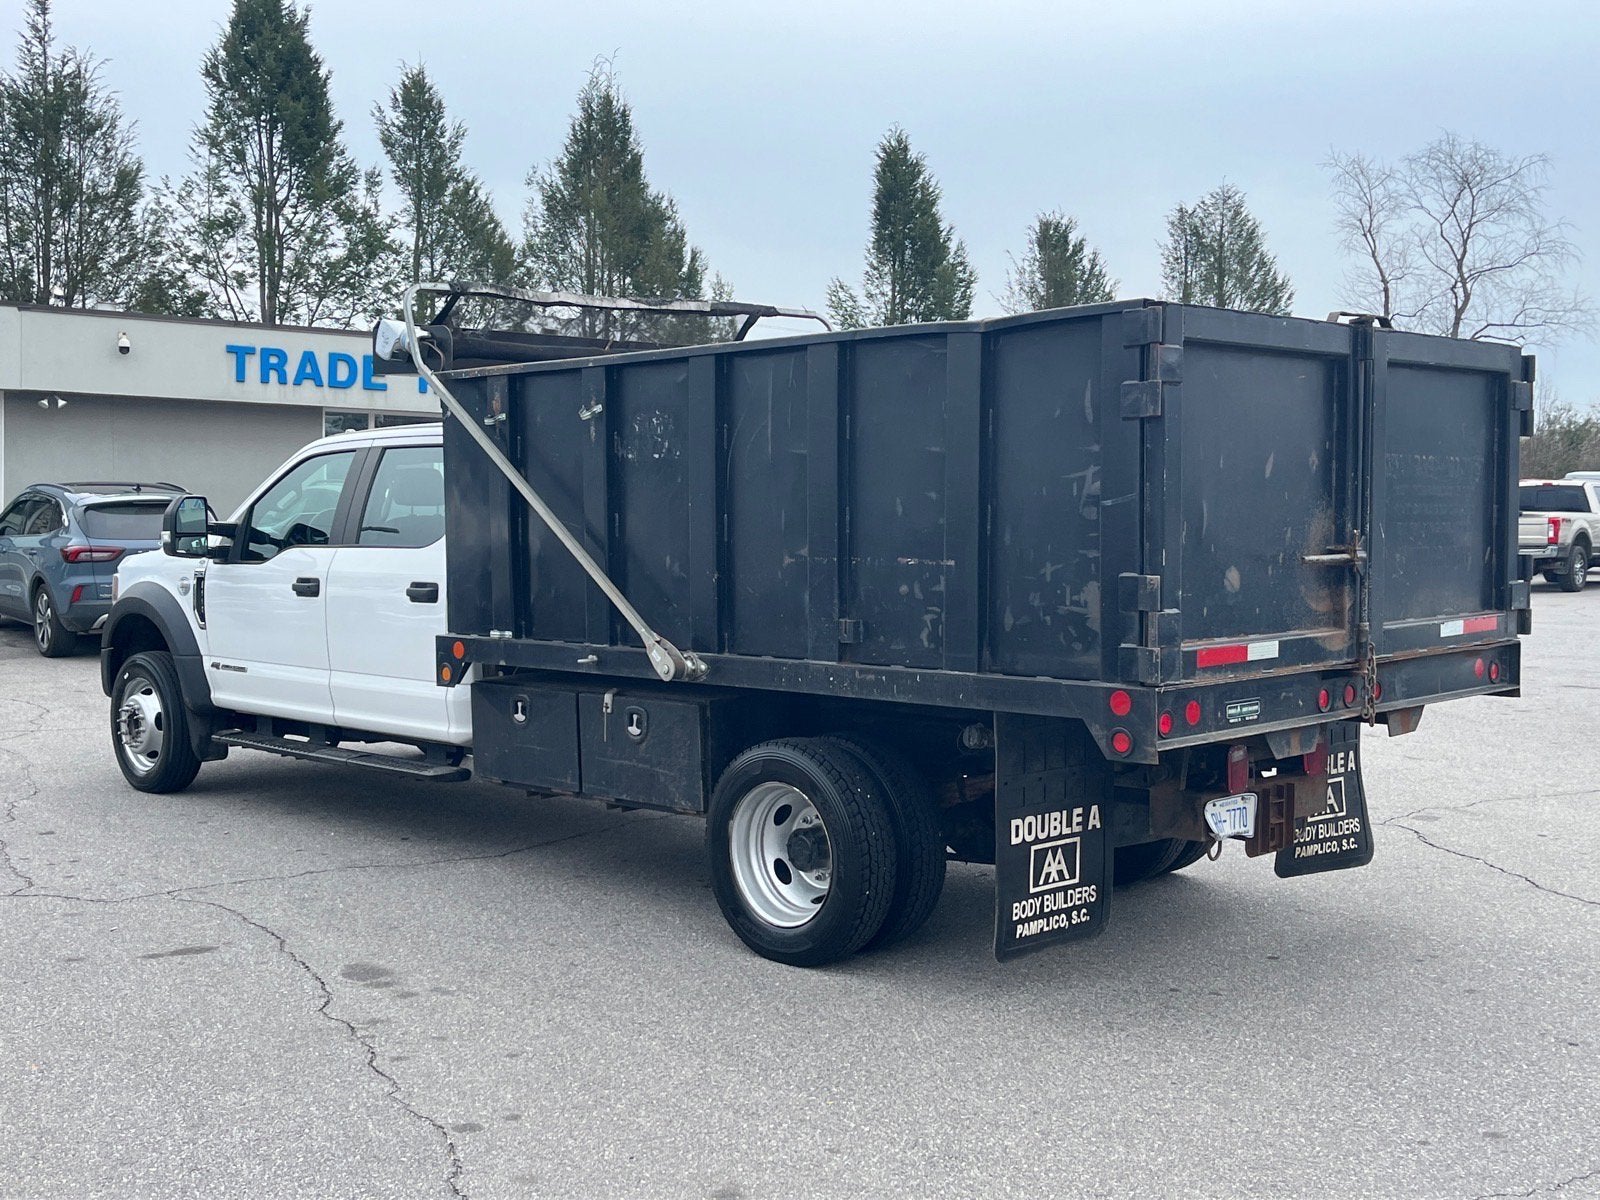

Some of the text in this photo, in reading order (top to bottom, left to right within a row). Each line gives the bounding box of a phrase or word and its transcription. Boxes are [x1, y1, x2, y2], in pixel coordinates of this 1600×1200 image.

[226, 344, 387, 391] TRADE
[1348, 751, 1356, 771] A
[1010, 805, 1101, 845] DOUBLE A
[1318, 817, 1360, 839] BUILDERS
[1295, 837, 1358, 859] PAMPLICO, S.C.
[1012, 884, 1097, 921] BODY BUILDERS
[1015, 908, 1090, 939] PAMPLICO, S.C.
